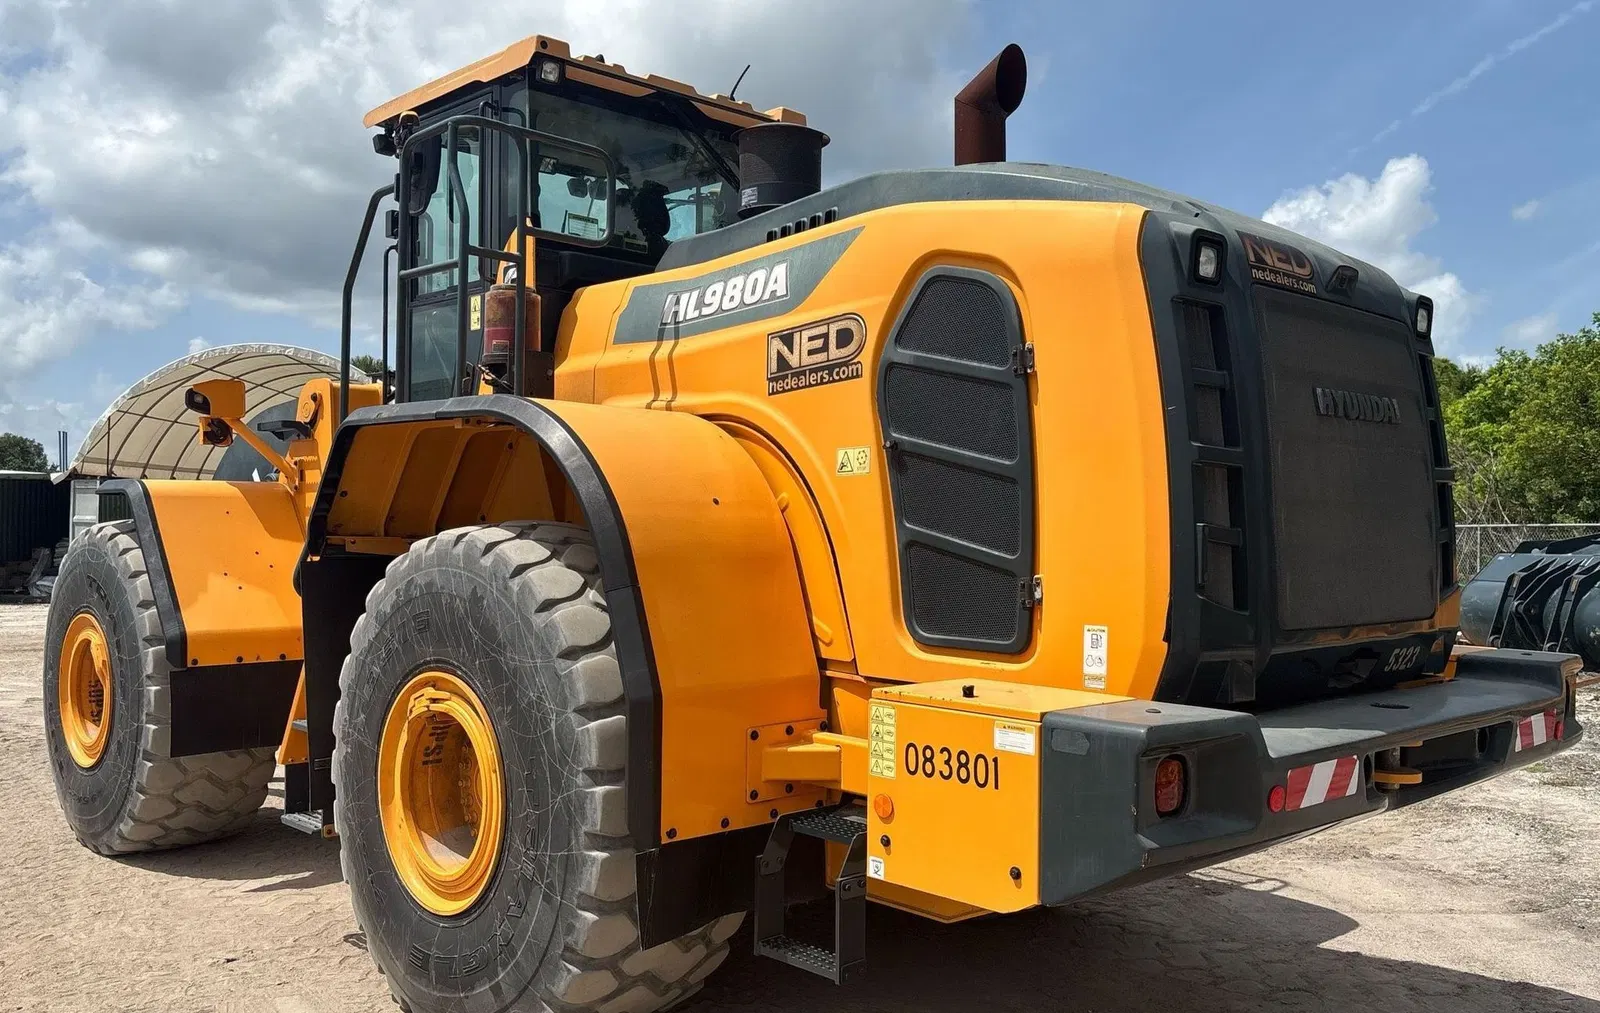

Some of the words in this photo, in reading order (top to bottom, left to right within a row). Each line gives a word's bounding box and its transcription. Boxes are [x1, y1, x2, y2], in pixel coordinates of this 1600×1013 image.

[1244, 238, 1312, 276] NED
[661, 262, 789, 325] HL980A
[1251, 268, 1317, 293] nedealers.com
[769, 320, 863, 373] NED
[768, 363, 862, 394] nedealers.com
[1315, 386, 1403, 425] HYUNDAI
[1384, 646, 1420, 671] 5323
[905, 742, 999, 790] 083801
